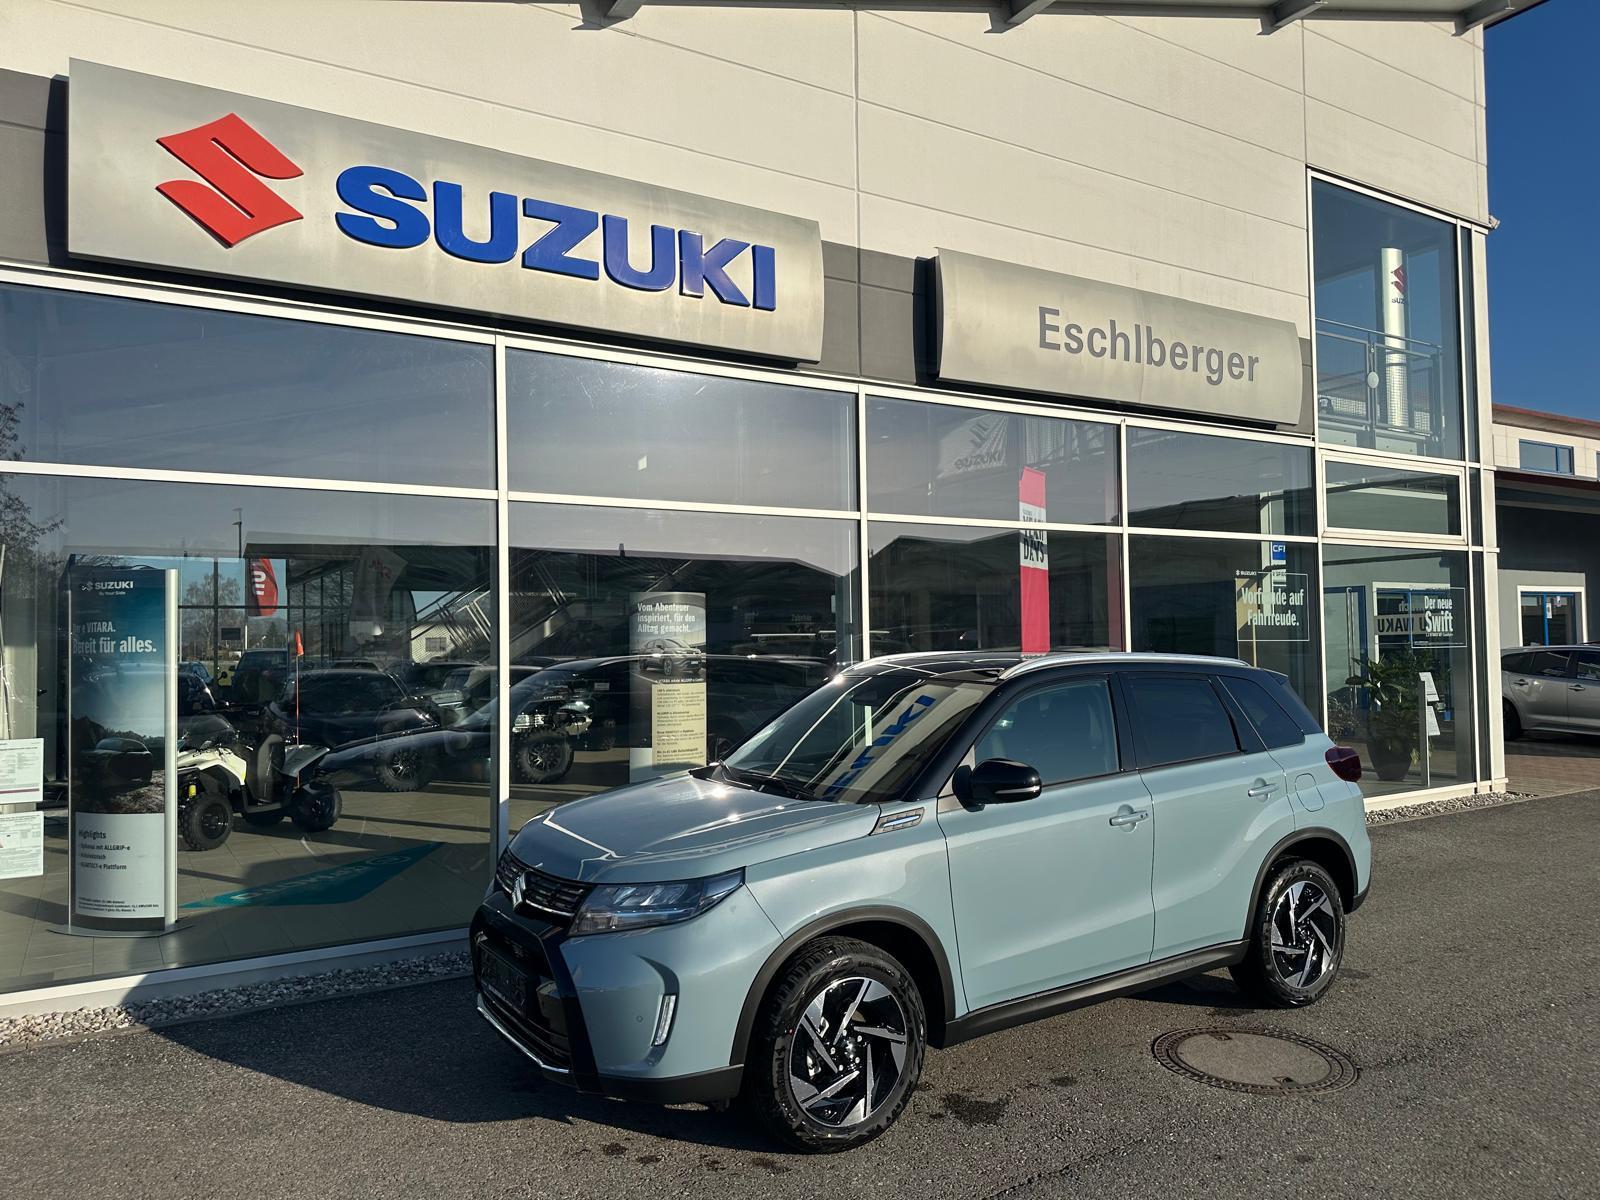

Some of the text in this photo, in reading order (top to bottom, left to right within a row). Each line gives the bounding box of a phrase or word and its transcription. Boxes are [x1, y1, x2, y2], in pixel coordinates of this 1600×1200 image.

[335, 165, 776, 311] SUZUKI
[1038, 306, 1259, 386] Eschlberger
[95, 581, 134, 590] SUZUKI
[1289, 588, 1305, 606] auf
[1424, 595, 1436, 610] Der
[1437, 596, 1453, 610] neue
[637, 602, 690, 612] Vom Abenteuer
[637, 613, 695, 624] inspiriert, für den
[1425, 610, 1453, 633] Swift
[86, 621, 116, 633] VITARA.
[637, 623, 691, 635] Alltag gemacht.
[73, 636, 157, 654] Bereit für alles.
